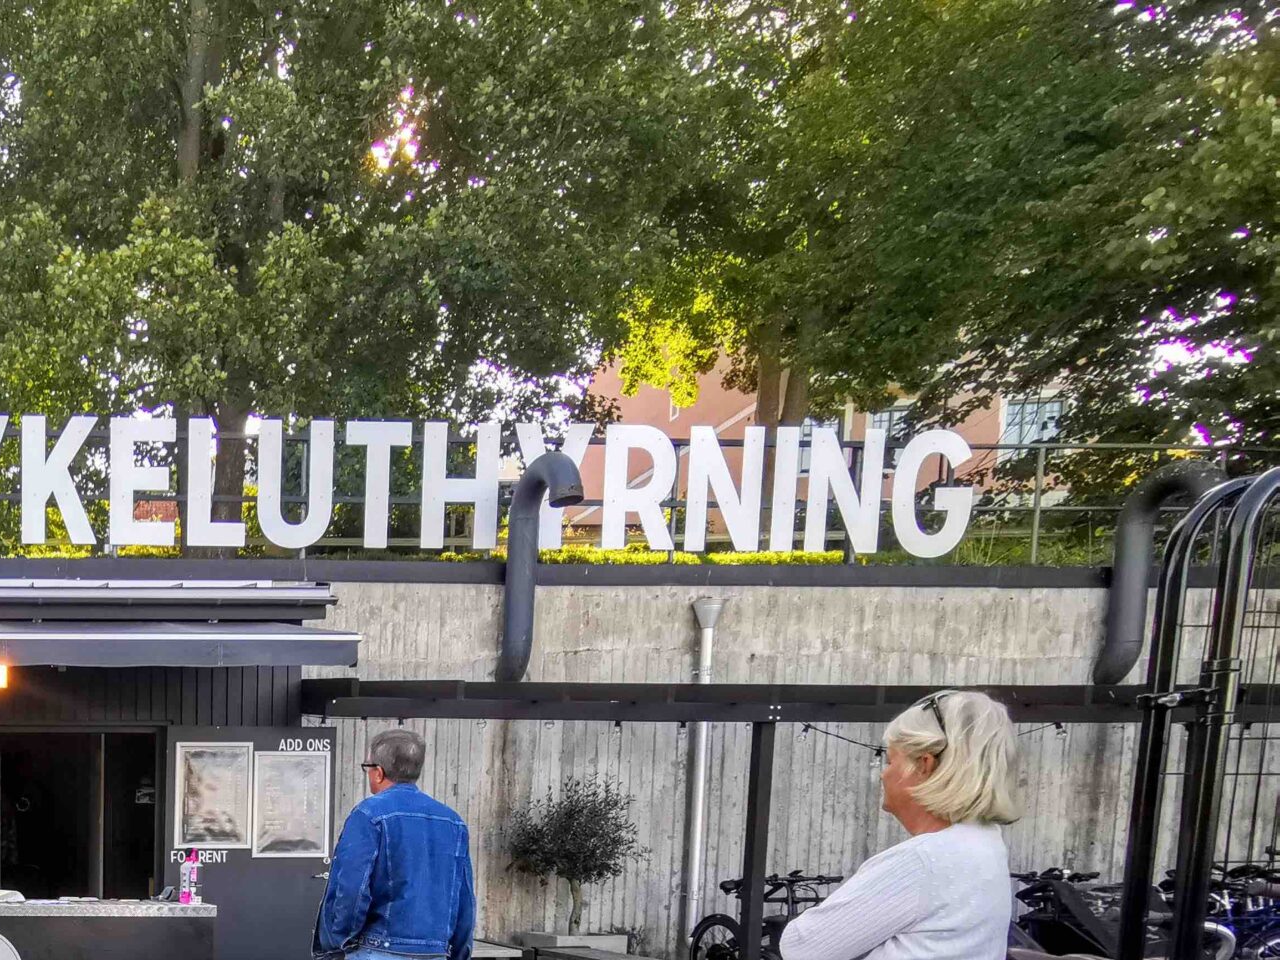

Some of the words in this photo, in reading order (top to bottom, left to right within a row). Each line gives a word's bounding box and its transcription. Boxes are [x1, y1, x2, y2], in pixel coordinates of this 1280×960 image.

[278, 738, 303, 751] ADD
[306, 738, 331, 751] ONS
[198, 850, 228, 864] RENT
